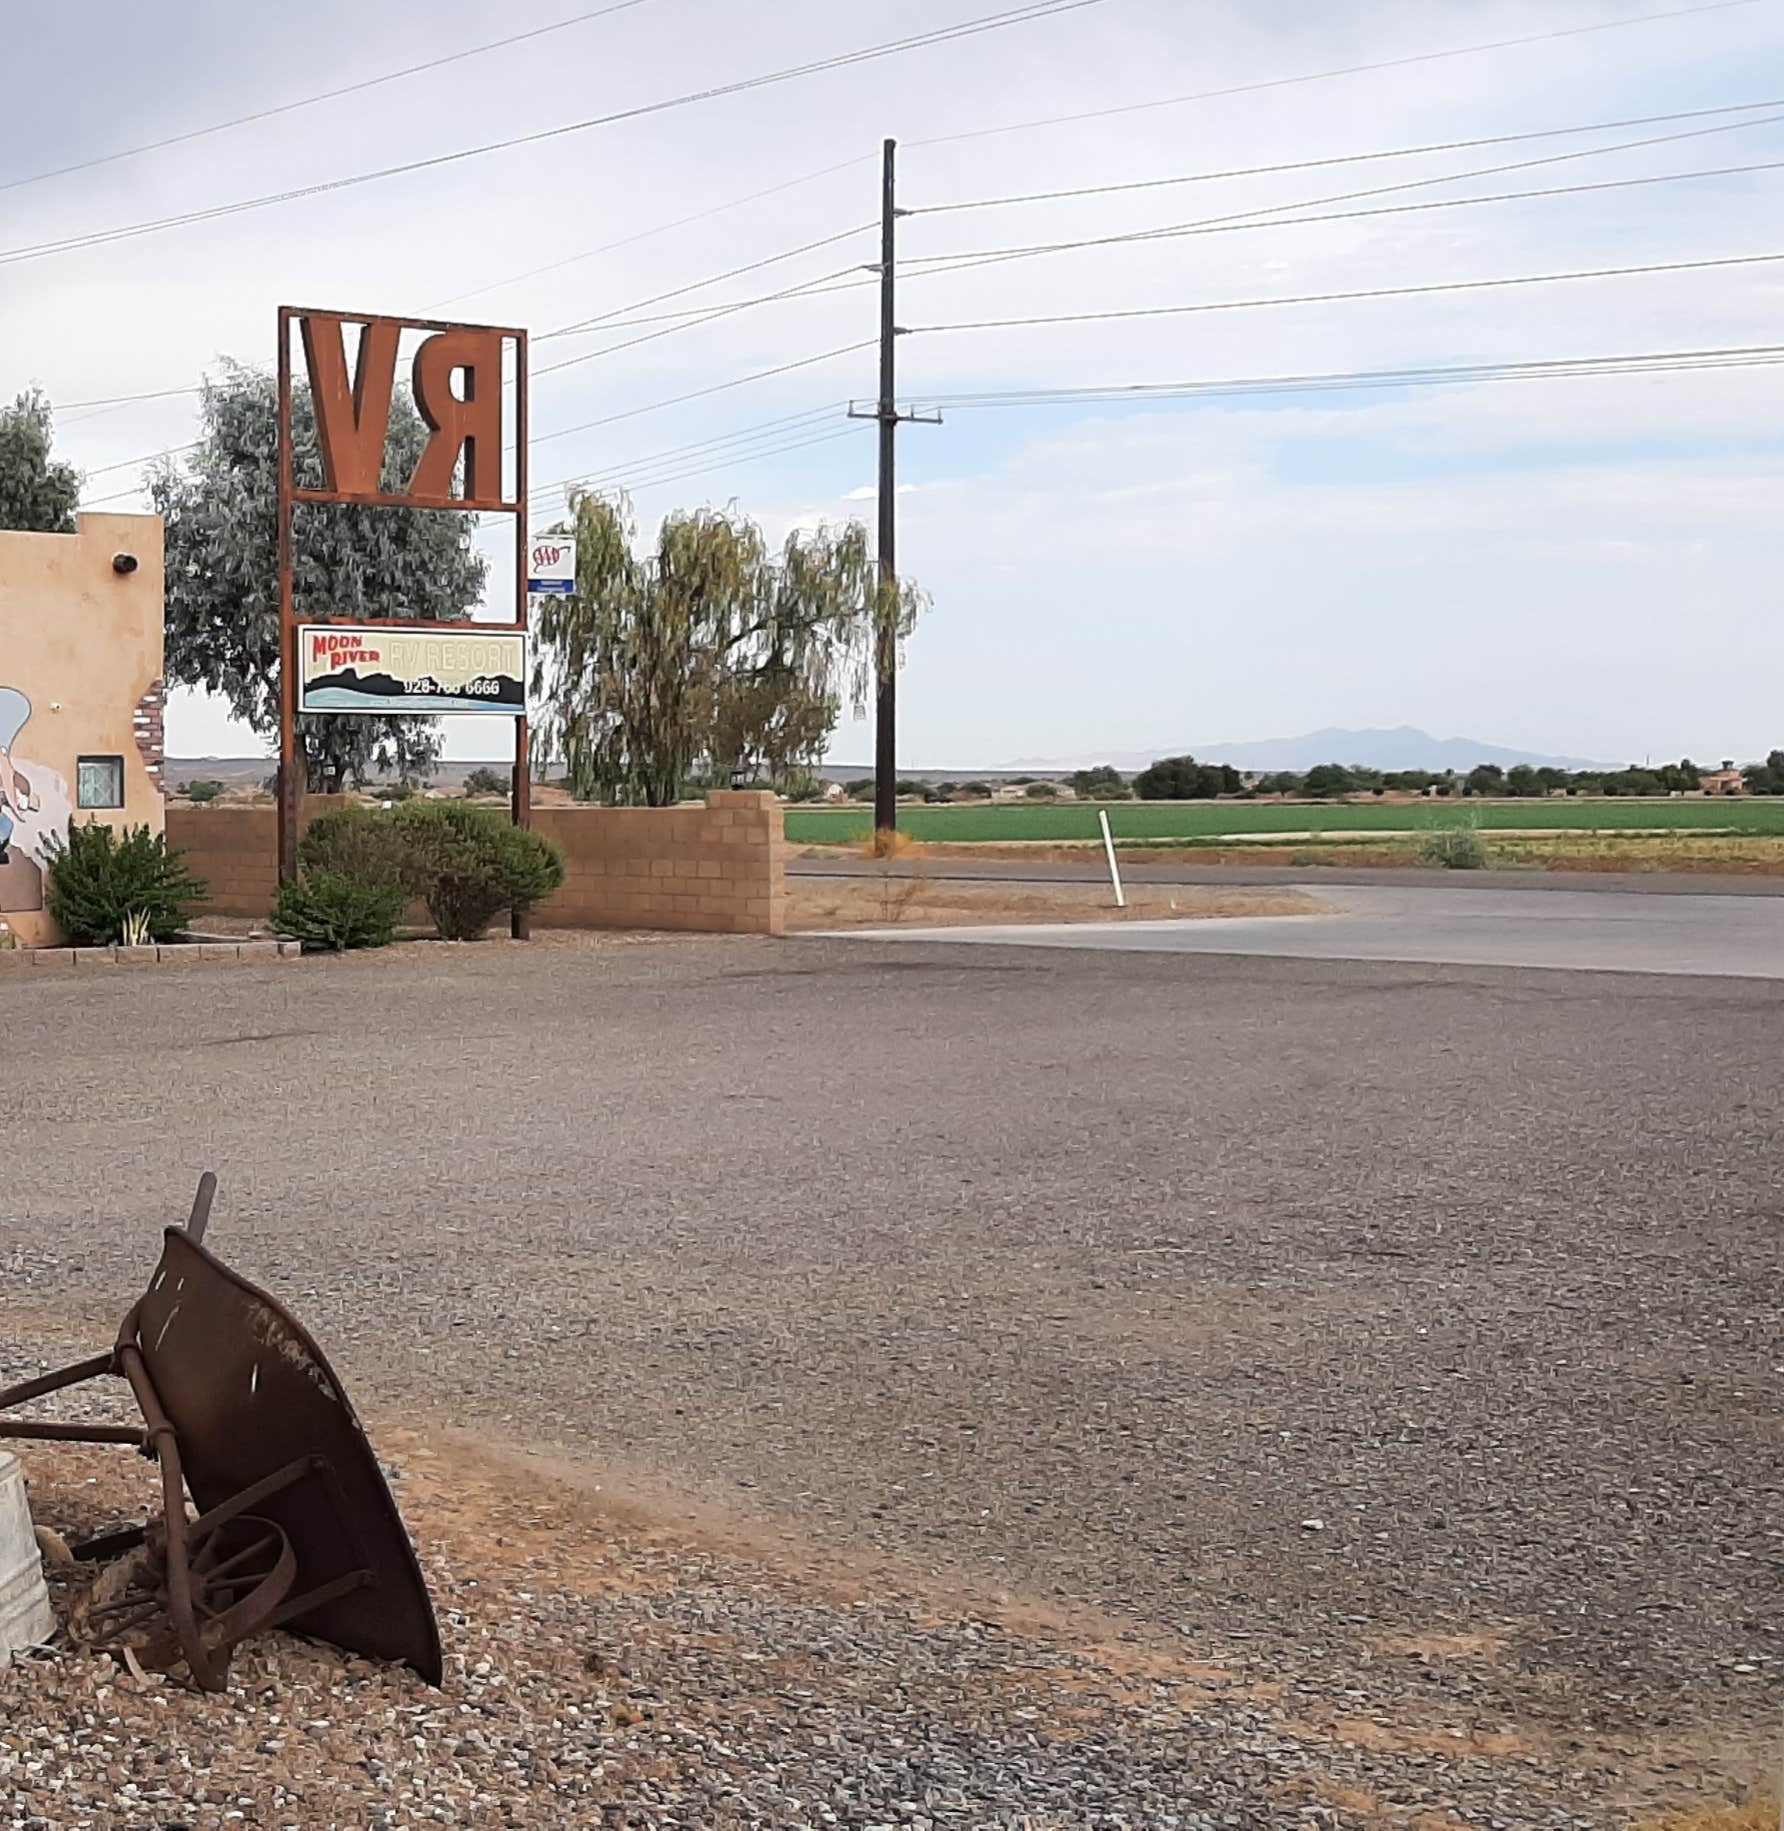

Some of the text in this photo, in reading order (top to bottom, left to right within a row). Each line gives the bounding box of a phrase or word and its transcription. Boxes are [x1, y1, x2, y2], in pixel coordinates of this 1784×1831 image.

[313, 635, 362, 662] MOON
[330, 650, 381, 671] RIVER
[426, 641, 515, 672] RESORT
